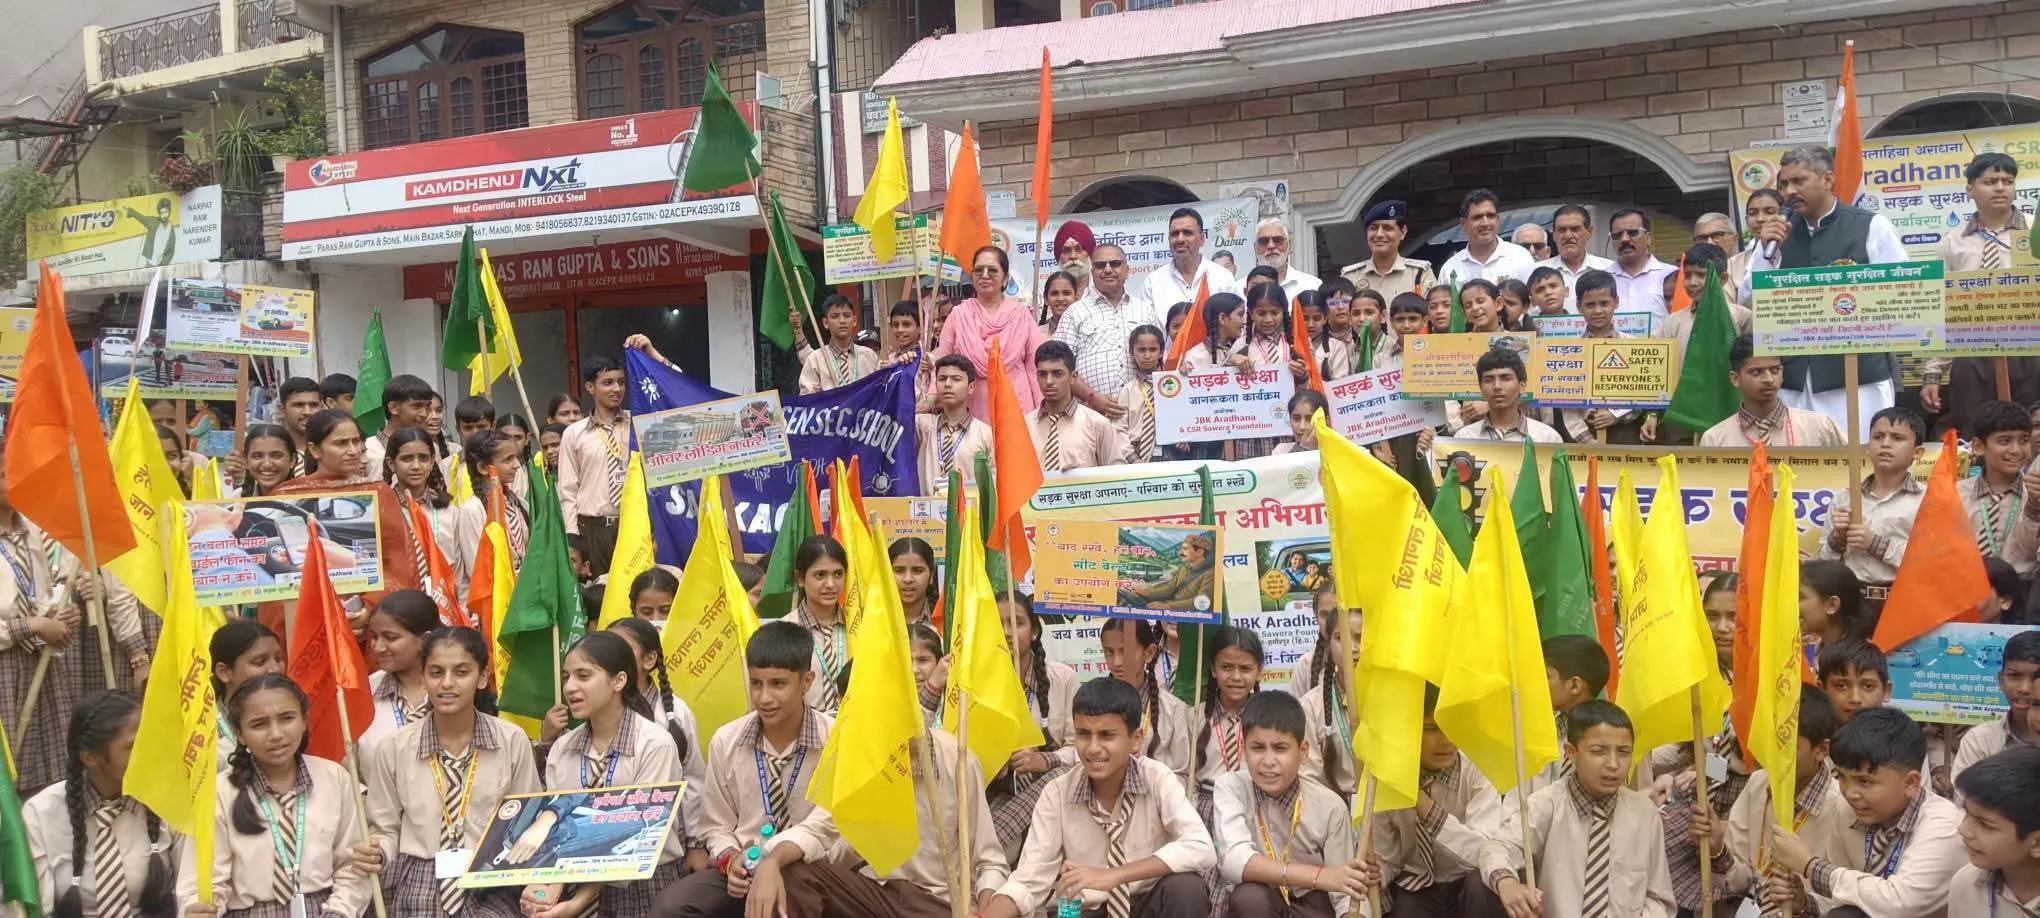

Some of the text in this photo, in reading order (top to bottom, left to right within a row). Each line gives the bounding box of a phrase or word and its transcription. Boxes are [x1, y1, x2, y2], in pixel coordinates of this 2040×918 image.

[412, 158, 582, 197] KAMDHENU Nxt
[187, 202, 212, 211] NARPAT
[452, 191, 587, 214] Next Generation INTERLOCK Steel
[1884, 194, 1923, 211] सड़क
[193, 214, 208, 223] RAM
[1892, 214, 1942, 228] पर्यावरण
[182, 224, 218, 235] NARENDER
[188, 236, 212, 246] KUMAR
[338, 240, 354, 250] RAM
[354, 238, 376, 248] GUPTA
[376, 238, 382, 246] &
[1139, 232, 1166, 246] द्वारा
[1214, 236, 1247, 248] Dabur
[522, 258, 552, 280] RAM
[558, 252, 602, 276] GUPTA
[611, 252, 622, 270] &
[628, 244, 670, 268] SONS
[1814, 270, 1843, 282] सड़क
[1847, 268, 1886, 284] सुरक्षित
[1996, 272, 2030, 286] जीवन
[1547, 344, 1584, 356] सड़क
[1630, 348, 1659, 356] ROAD
[1546, 360, 1584, 373] सुरक्षा
[1628, 357, 1664, 365] SAFETY
[1640, 366, 1649, 374] IS
[1234, 369, 1280, 390] सुरक्षा
[1189, 388, 1280, 406] जागरूकता कार्यक्रम
[1336, 396, 1386, 416] जागरूकता
[1194, 414, 1256, 424] JBK Aradhana
[1364, 412, 1408, 429] Aradhana
[1186, 426, 1201, 434] CSR
[1203, 424, 1230, 433] Sawera
[1231, 422, 1273, 431] Foundation
[1356, 417, 1425, 440] Sawera Foundation
[1038, 493, 1062, 506] सड़क
[1065, 490, 1092, 506] सुरक्षा
[1136, 480, 1168, 496] परिवार
[1171, 478, 1186, 492] को
[239, 536, 268, 548] समय
[252, 554, 266, 566] का
[1072, 558, 1096, 570] सीट
[222, 572, 232, 583] न
[329, 570, 353, 578] radhana
[1164, 609, 1213, 620] Foundation
[1052, 628, 1100, 640] जय बाबा
[1262, 630, 1293, 638] Sawera
